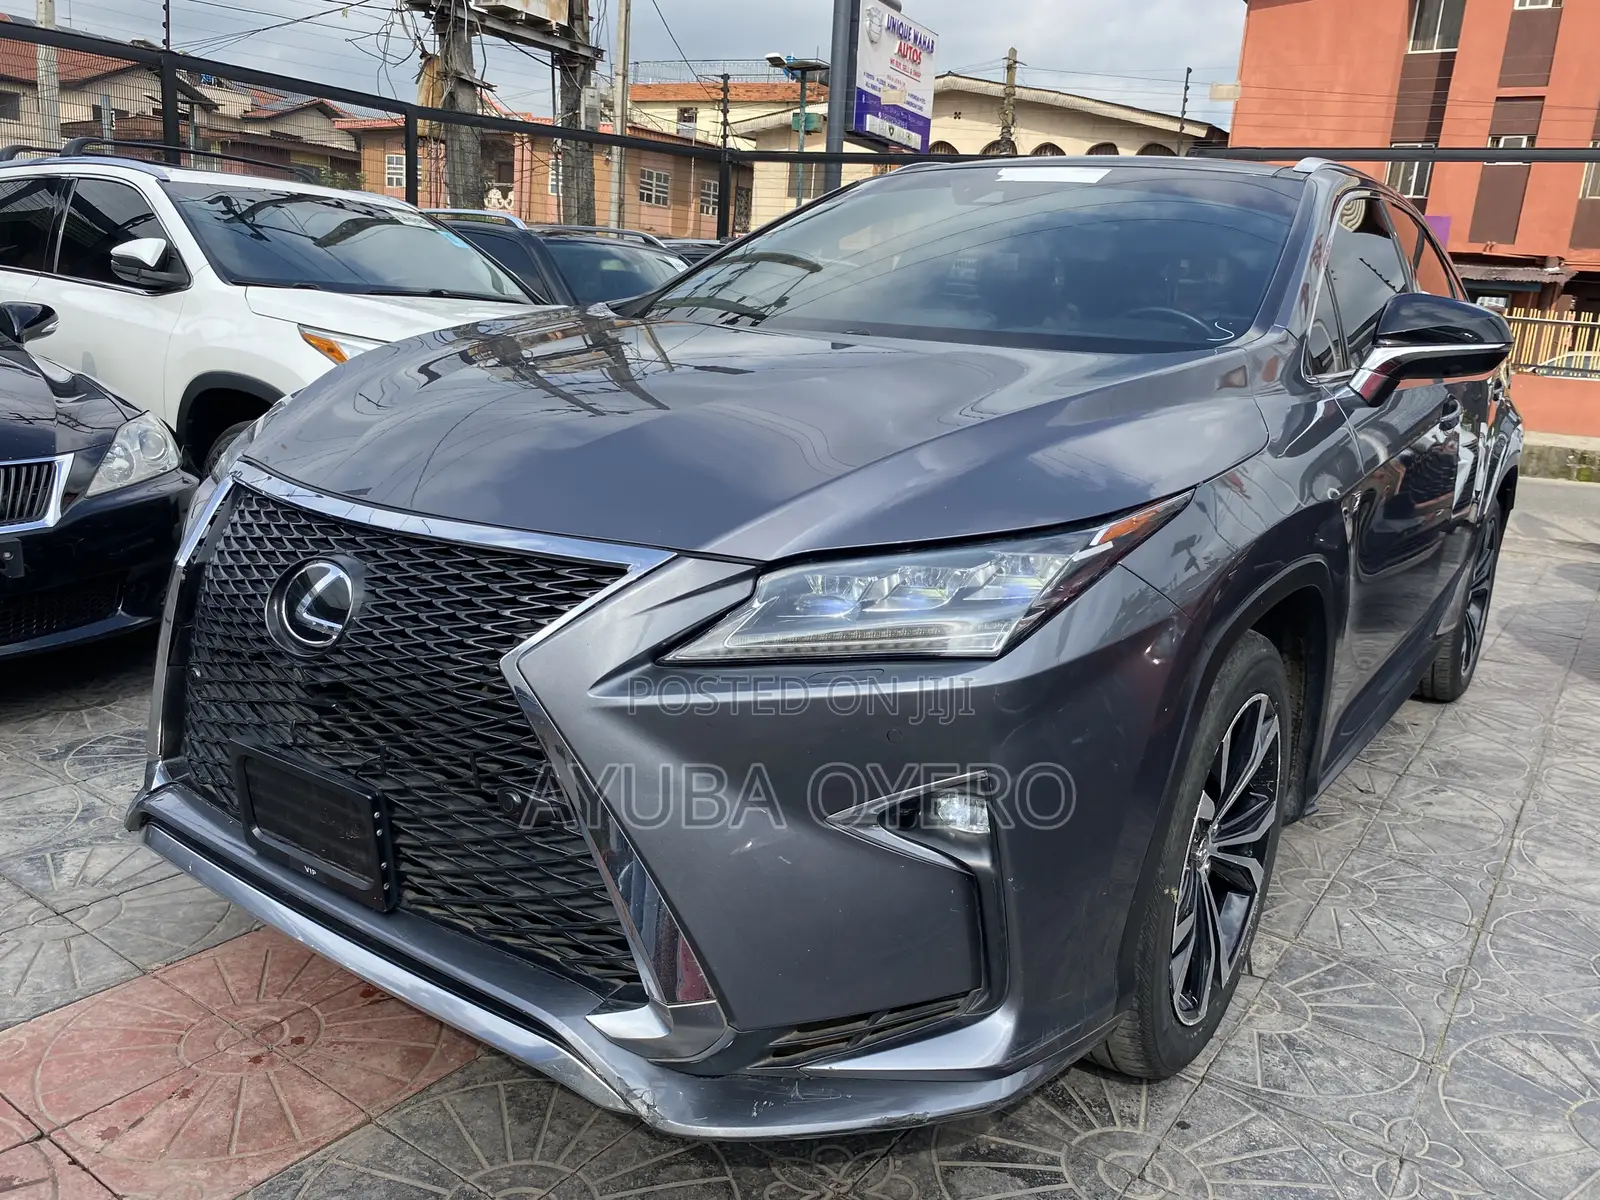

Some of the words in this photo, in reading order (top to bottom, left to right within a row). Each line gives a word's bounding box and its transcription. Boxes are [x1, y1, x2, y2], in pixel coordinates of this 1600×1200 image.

[886, 14, 911, 41] UNIQUE
[912, 29, 935, 54] WAHAB
[897, 41, 921, 65] AUTOS
[303, 865, 317, 875] VIP
